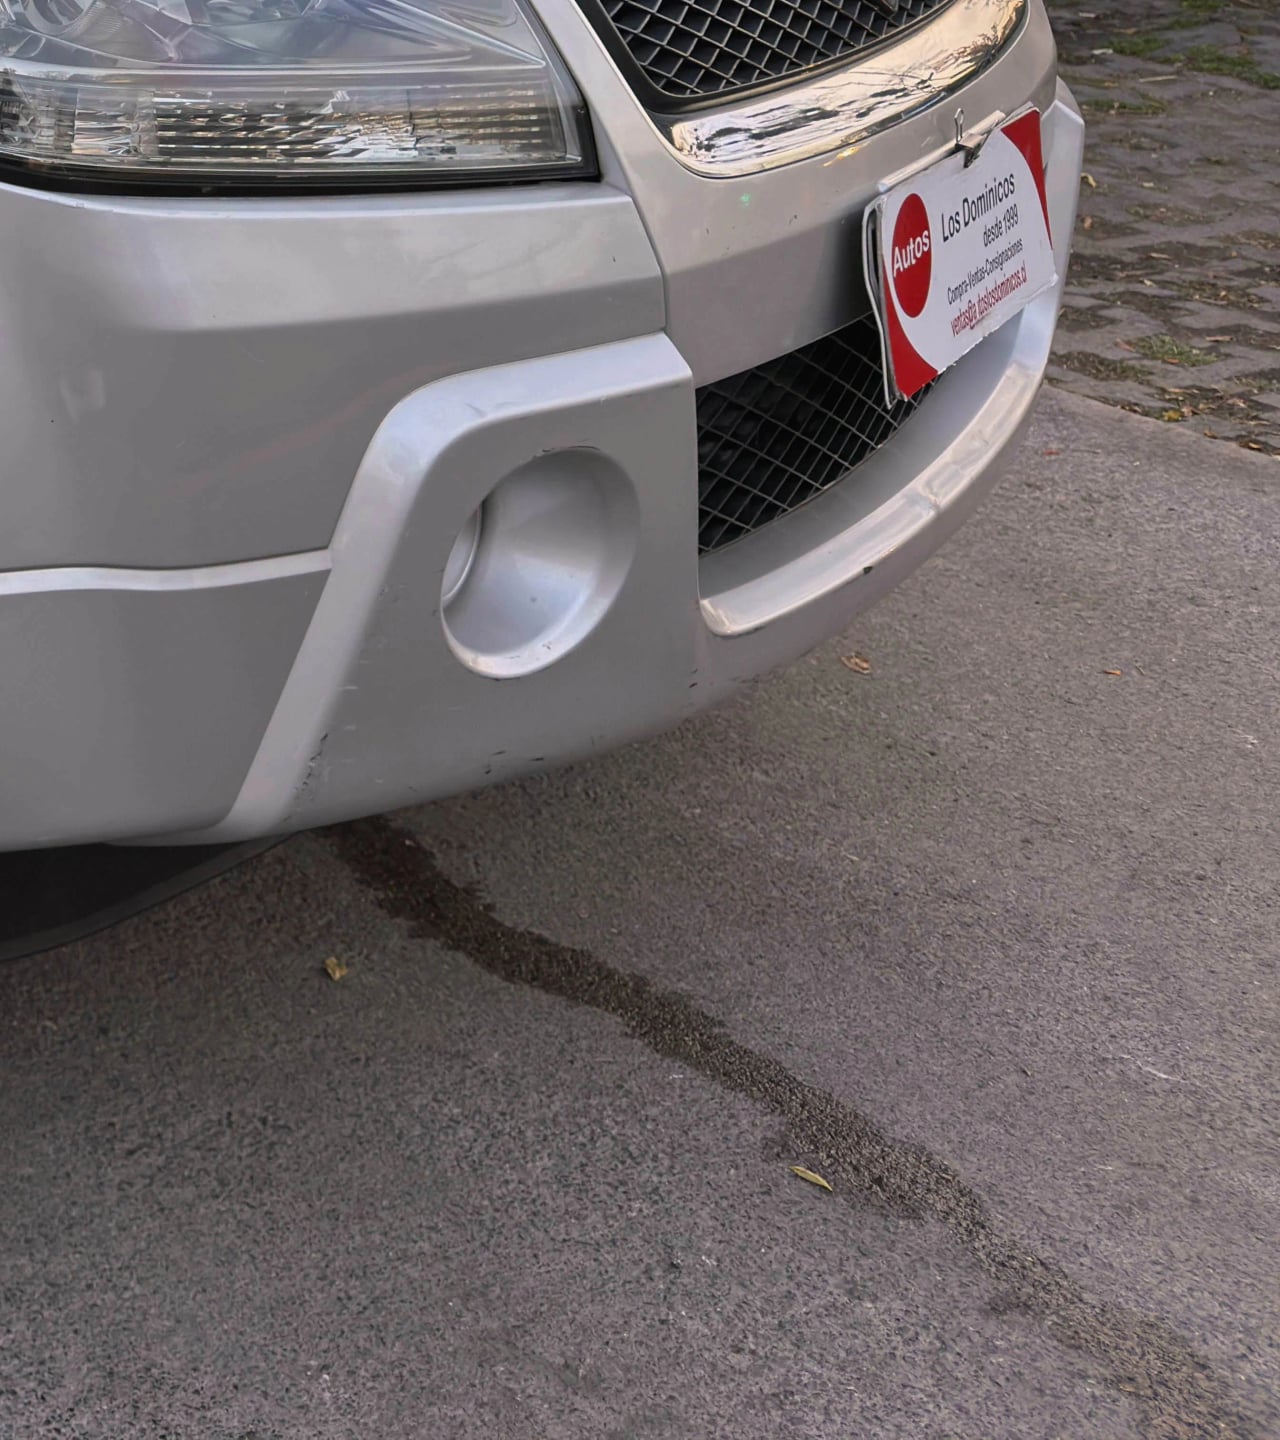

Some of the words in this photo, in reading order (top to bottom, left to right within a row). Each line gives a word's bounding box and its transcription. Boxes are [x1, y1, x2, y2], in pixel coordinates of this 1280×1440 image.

[942, 211, 961, 243] Los
[962, 173, 1015, 228] Dominicos
[983, 216, 1002, 247] desde
[893, 229, 931, 278] Autos
